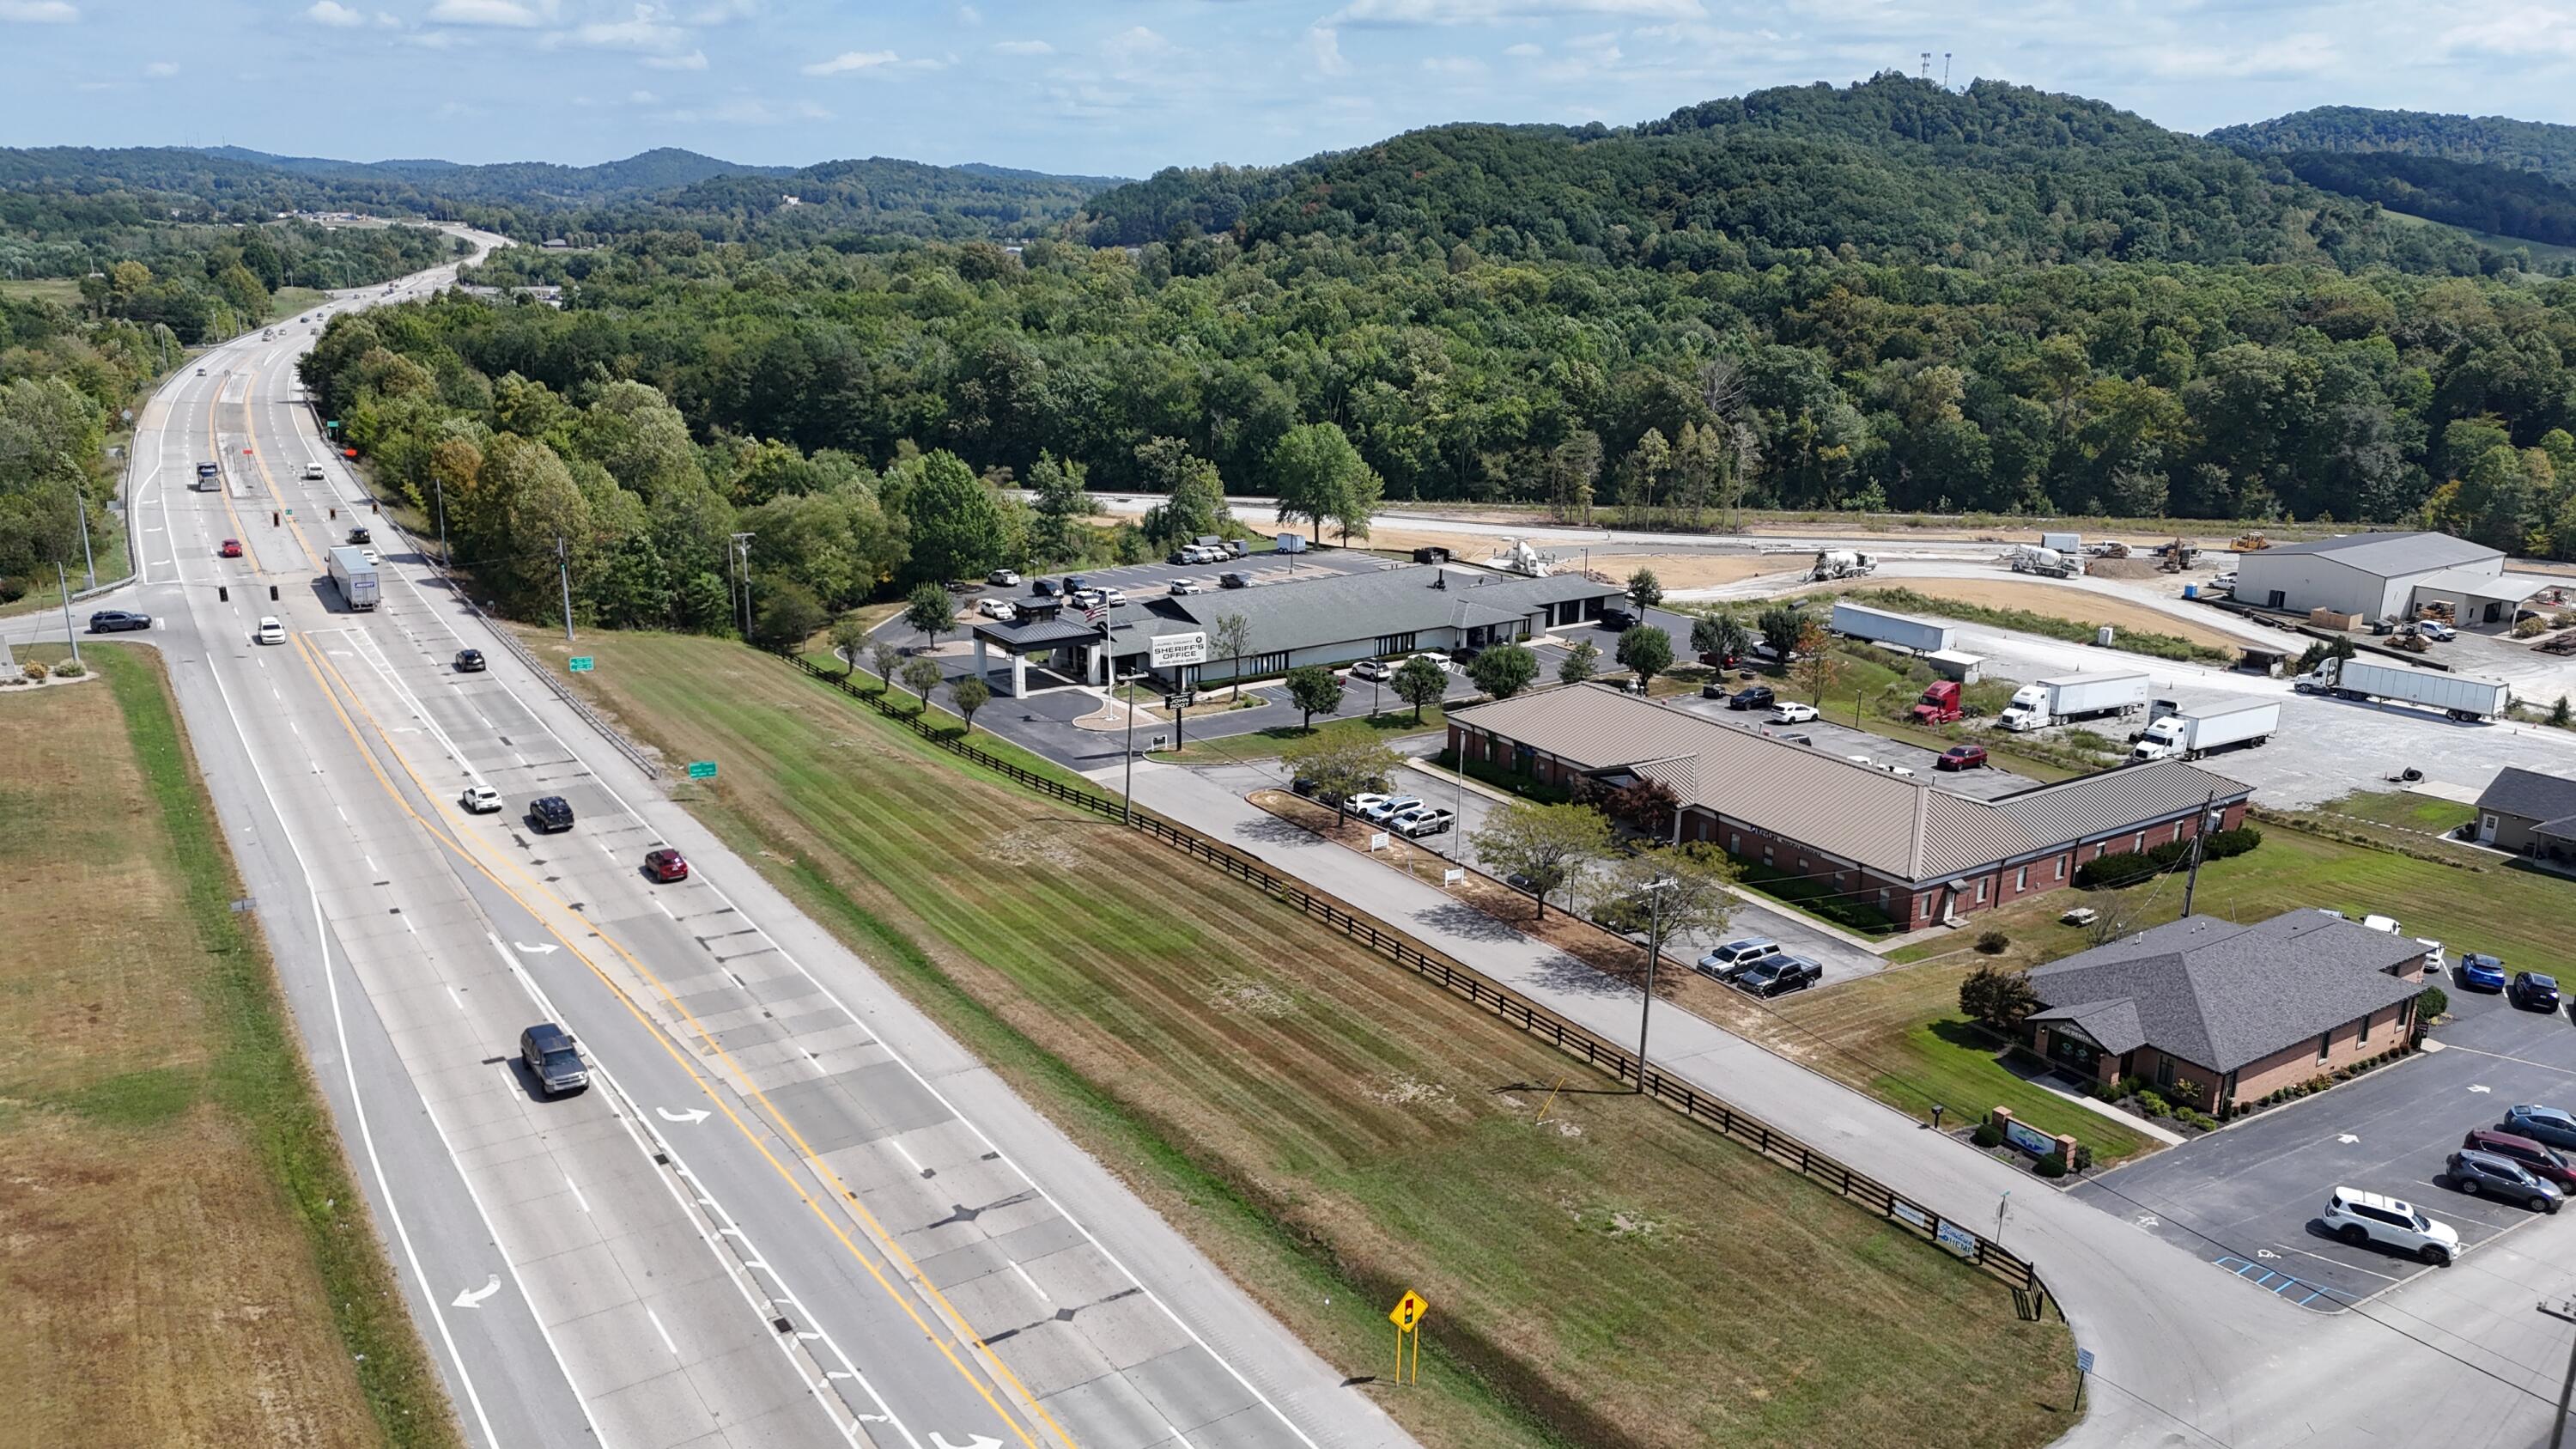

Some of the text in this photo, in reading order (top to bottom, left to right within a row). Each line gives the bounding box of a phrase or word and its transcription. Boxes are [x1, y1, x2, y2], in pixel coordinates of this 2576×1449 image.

[1154, 643, 1204, 654] SHERIFF'S
[1163, 650, 1196, 660] OFFICE
[2070, 1031, 2092, 1043] DENTAL
[1948, 1238, 1973, 1253] HEMP
